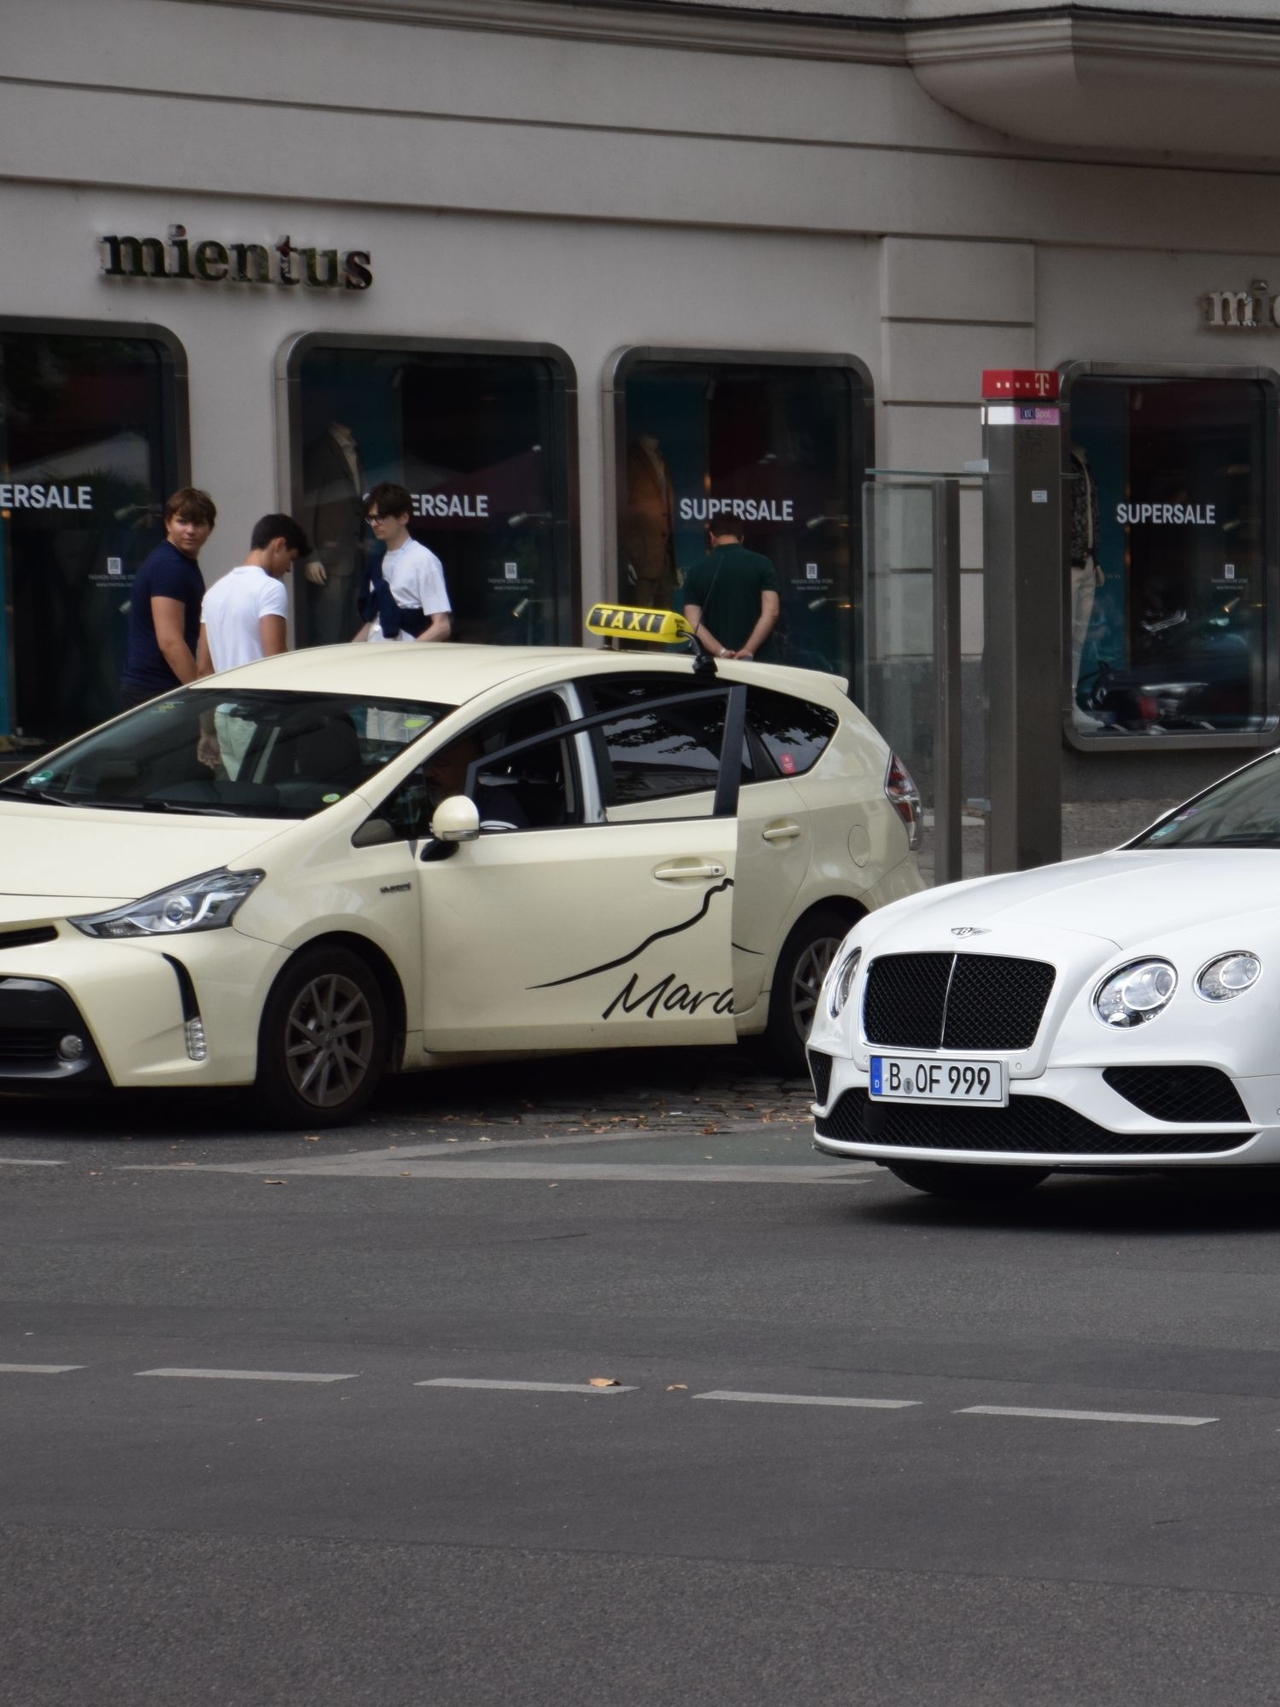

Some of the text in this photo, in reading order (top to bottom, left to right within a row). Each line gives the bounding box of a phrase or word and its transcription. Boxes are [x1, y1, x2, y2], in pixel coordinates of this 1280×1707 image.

[101, 223, 374, 291] mientus
[0, 484, 92, 509] ERSALE
[1116, 503, 1216, 525] SUPERSALE
[600, 609, 656, 632] TAXI
[874, 1062, 991, 1096] D B OF 999
